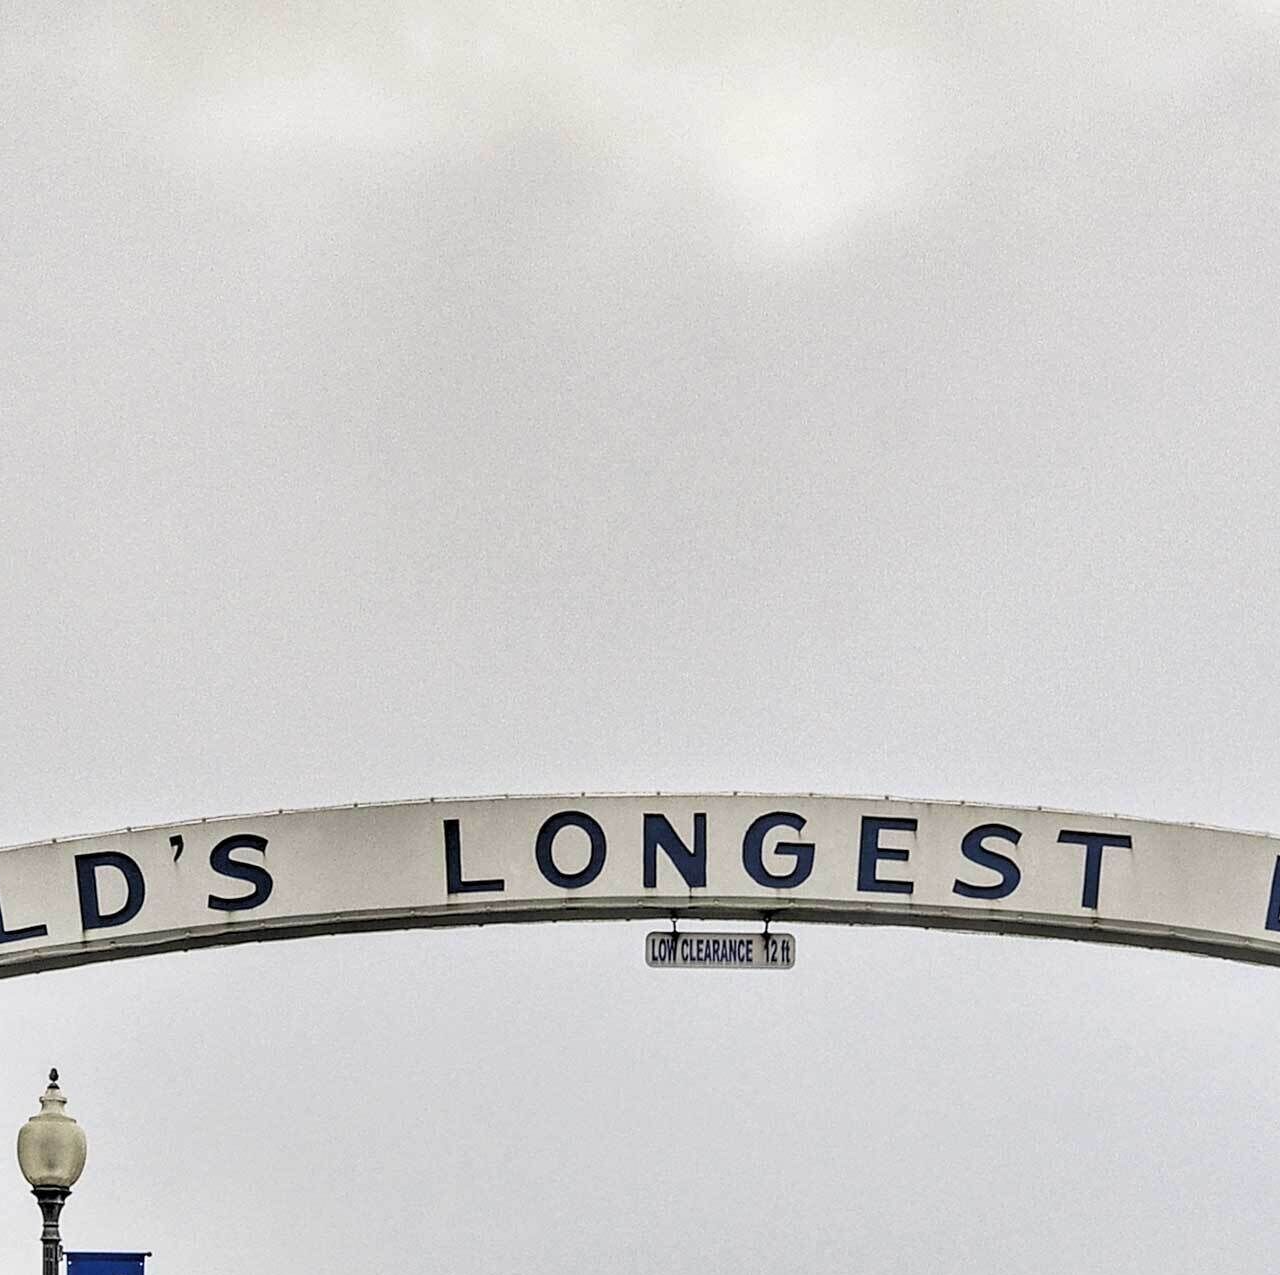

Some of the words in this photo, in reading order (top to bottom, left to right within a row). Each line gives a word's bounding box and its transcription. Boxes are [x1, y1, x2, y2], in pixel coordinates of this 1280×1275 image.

[443, 811, 1131, 908] LONGEST
[651, 939, 677, 963] LOW
[681, 938, 753, 963] CLEARANCE
[764, 939, 778, 963] 12
[781, 939, 791, 963] ft
